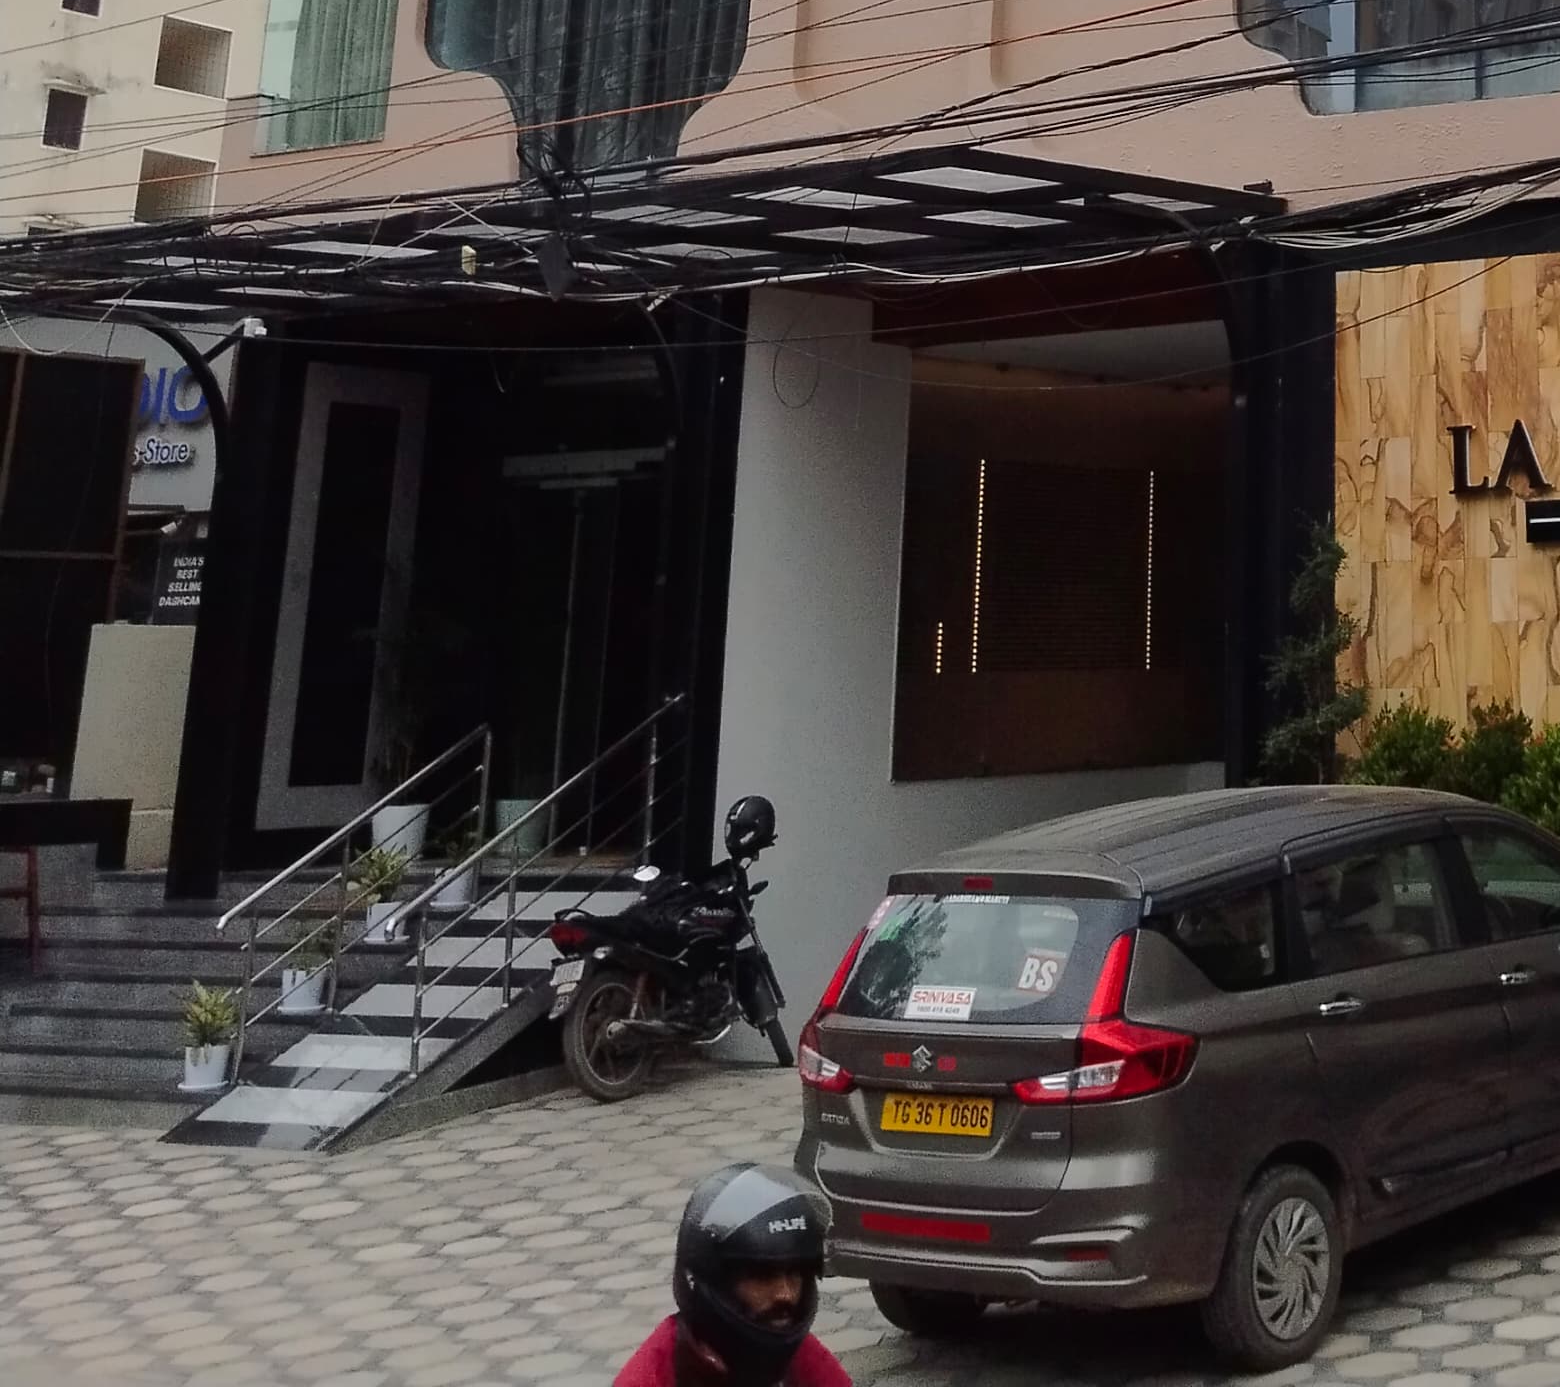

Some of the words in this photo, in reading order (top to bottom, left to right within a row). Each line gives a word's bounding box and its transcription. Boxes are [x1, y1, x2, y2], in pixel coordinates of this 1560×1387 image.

[1446, 418, 1555, 495] LA
[911, 990, 972, 1005] SRINIVASA
[893, 1099, 911, 1124] TG
[914, 1101, 934, 1126] 36
[938, 1103, 947, 1127] T
[950, 1103, 990, 1129] 0606
